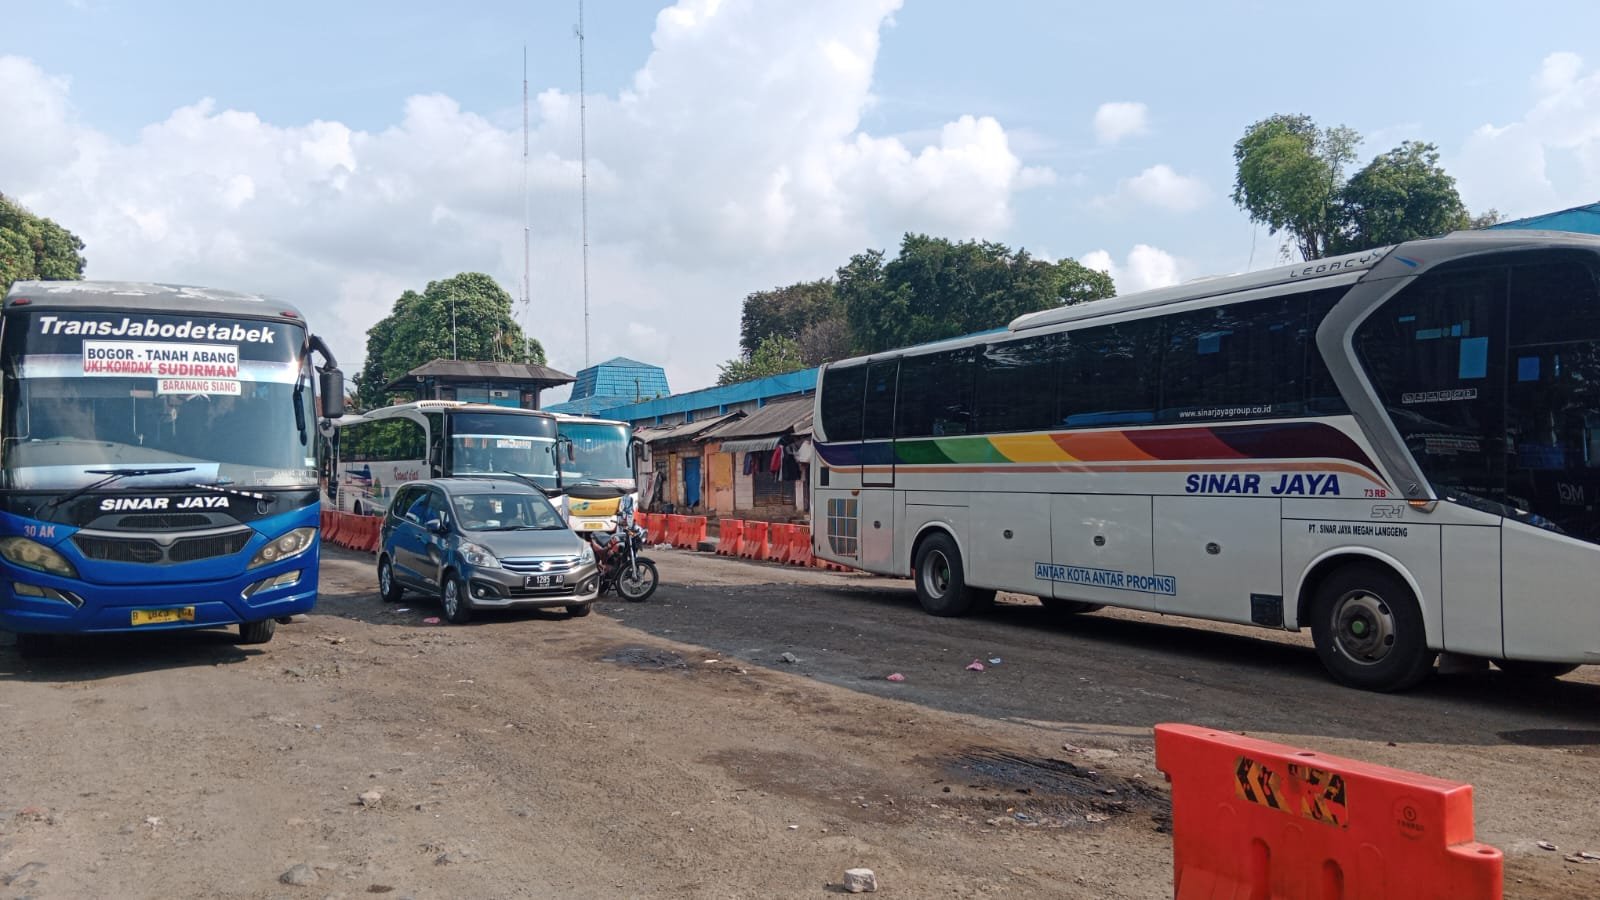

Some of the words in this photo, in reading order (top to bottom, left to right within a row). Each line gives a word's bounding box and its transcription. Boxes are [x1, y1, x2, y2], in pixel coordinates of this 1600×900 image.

[1290, 255, 1371, 278] LEGACY
[39, 315, 276, 344] TransJabodetabek
[88, 348, 134, 361] BOGOR
[145, 349, 188, 362] TANAH
[192, 351, 236, 364] ABANG
[158, 362, 237, 378] SUDIRMAN
[162, 380, 209, 392] BARANANG
[211, 381, 237, 393] SIANG
[1179, 404, 1272, 418] www.sinarjayagroup.co.id
[1185, 473, 1261, 494] SINAR
[1270, 474, 1340, 496] JAYA
[1364, 488, 1374, 498] 73
[1374, 489, 1386, 498] RB
[99, 497, 170, 511] SINAR
[176, 496, 230, 508] JAYA
[23, 524, 36, 537] 30
[39, 525, 56, 538] AK
[1319, 524, 1337, 535] SINAR
[1337, 525, 1352, 535] JAYA
[1352, 525, 1374, 536] MEGAH
[1374, 527, 1408, 538] LANGGENG
[526, 576, 531, 585] F
[1036, 565, 1065, 580] ANTAR
[1067, 567, 1091, 582] KOTA
[1092, 571, 1124, 587] ANTAR
[1126, 574, 1174, 593] PROPINSI
